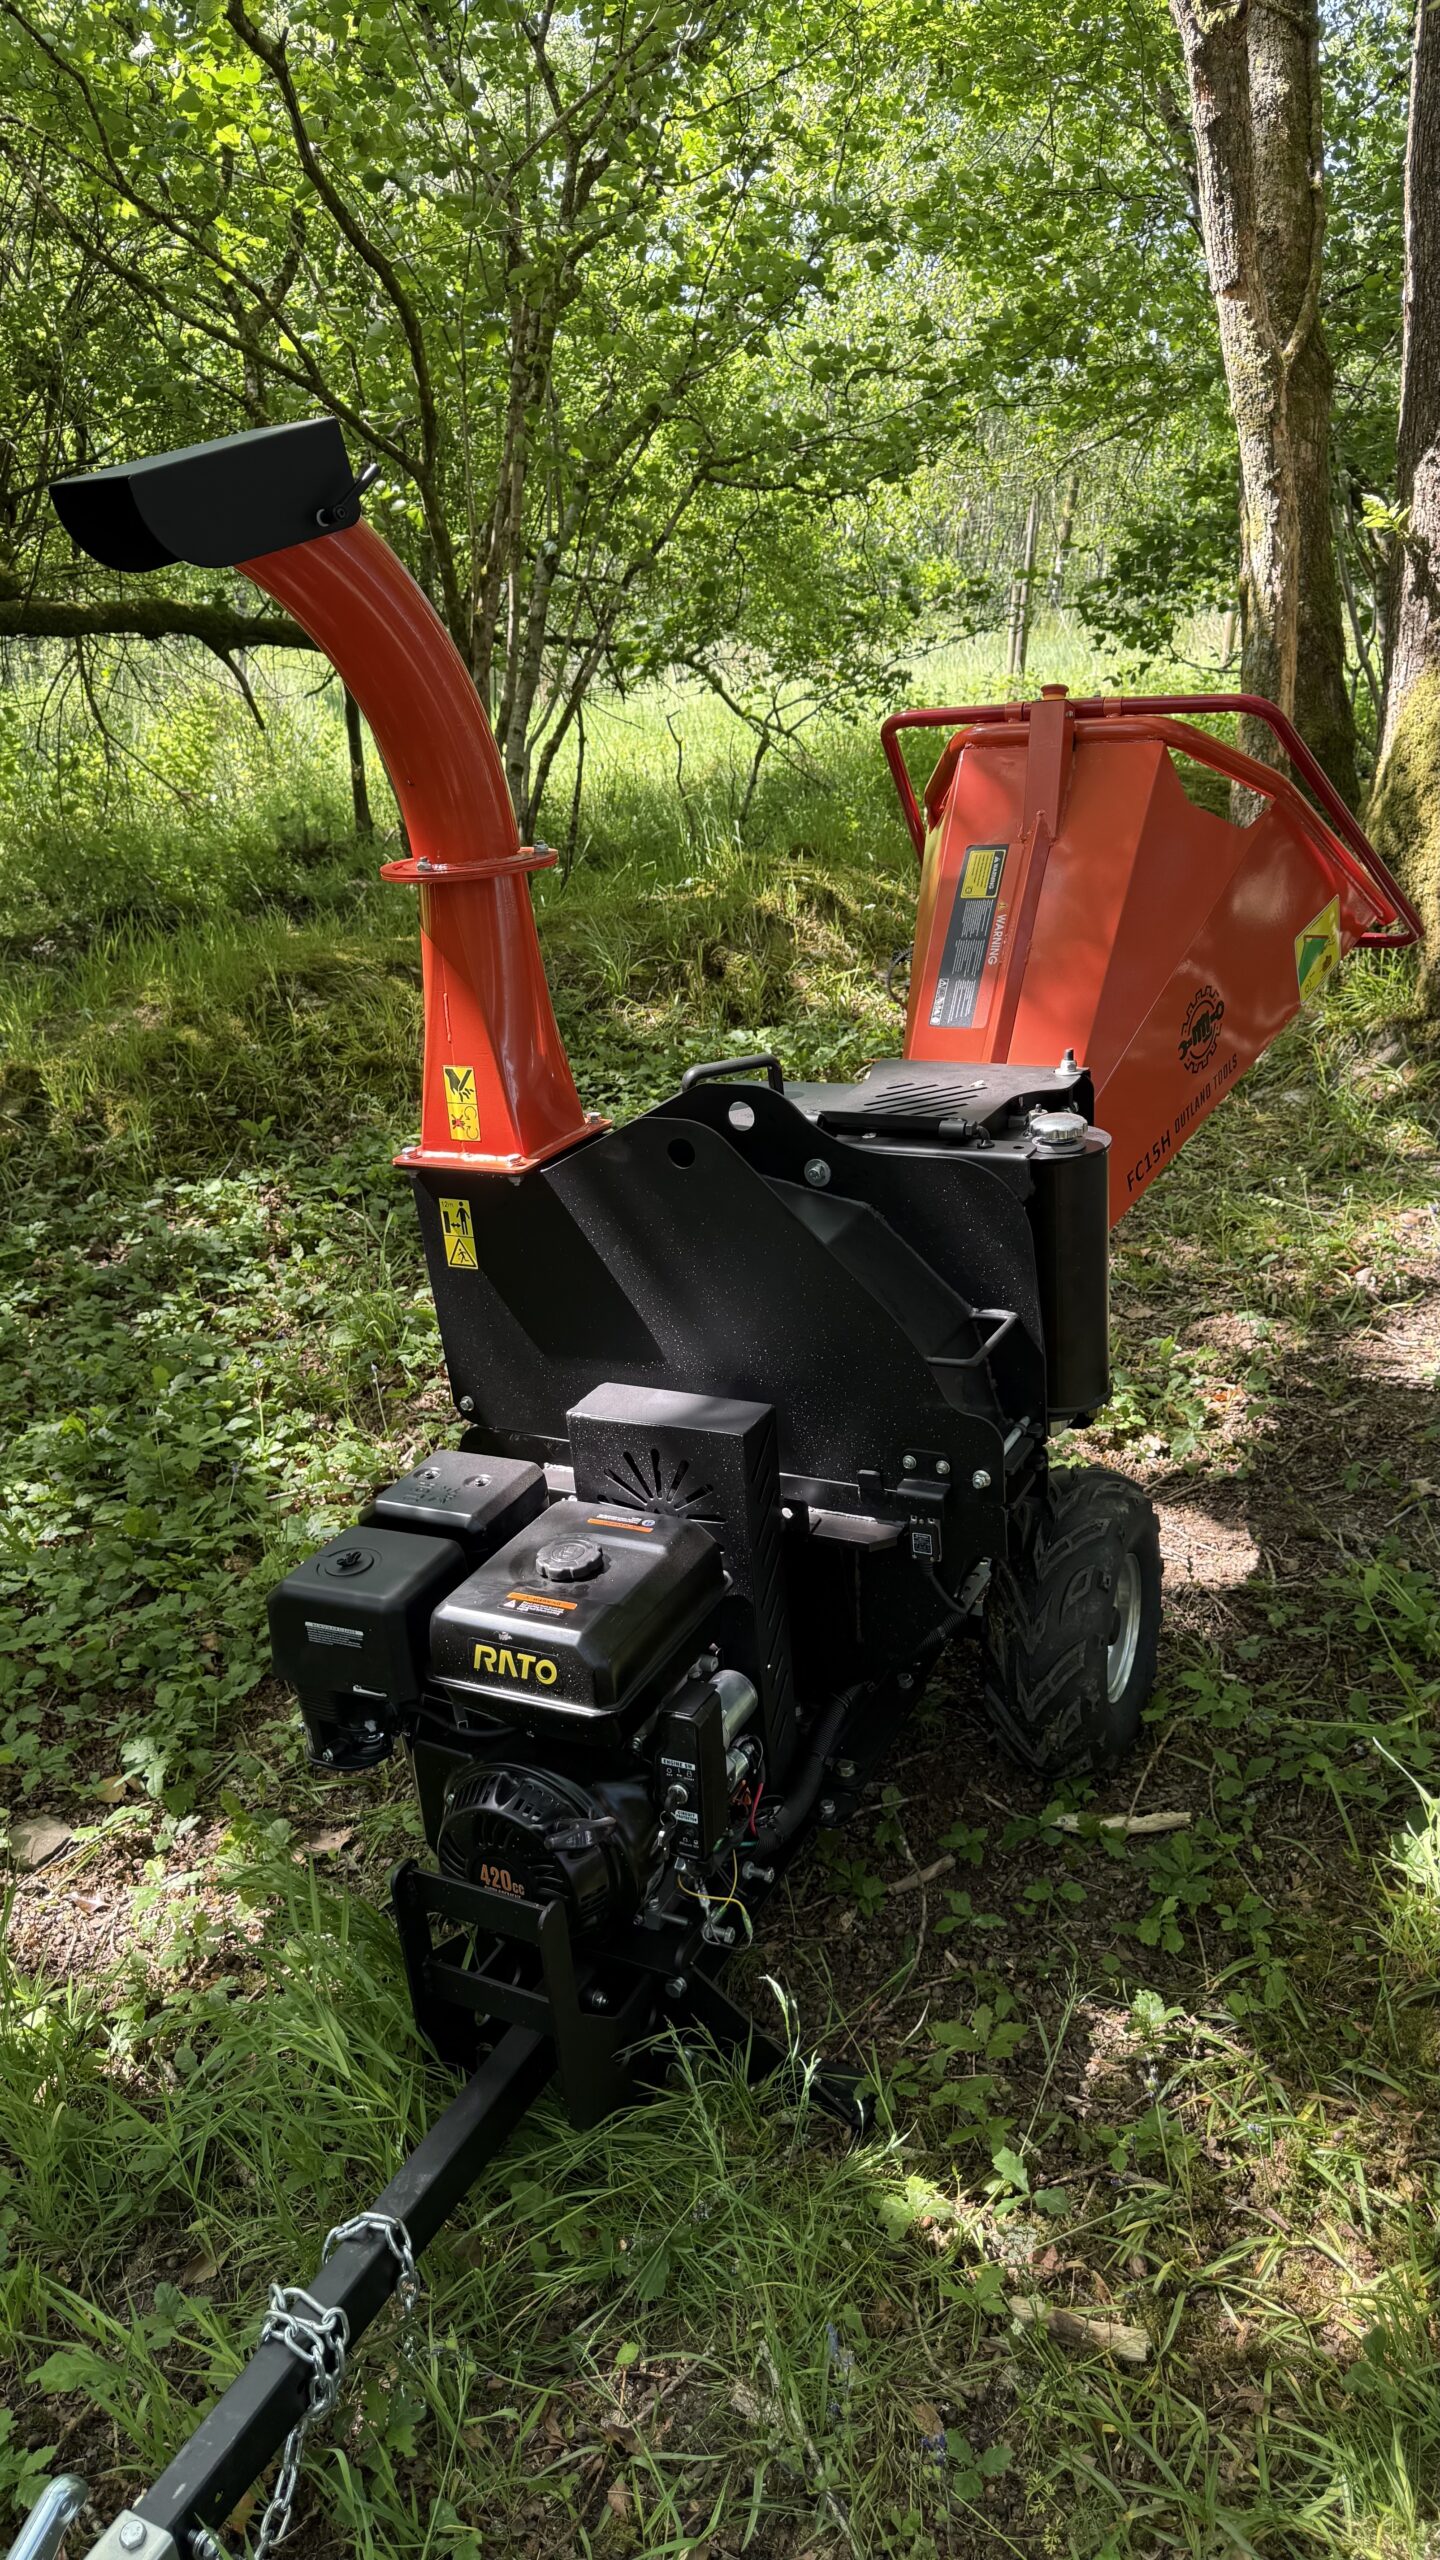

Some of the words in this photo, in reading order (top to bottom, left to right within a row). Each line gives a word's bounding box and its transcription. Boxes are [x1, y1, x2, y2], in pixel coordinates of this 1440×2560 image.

[988, 914, 1007, 965] WARNING
[1174, 1083, 1211, 1134] OUTLAND
[1213, 1053, 1238, 1090] TOOLS
[1127, 1129, 1171, 1192] FC15H
[473, 1643, 557, 1685] RATO
